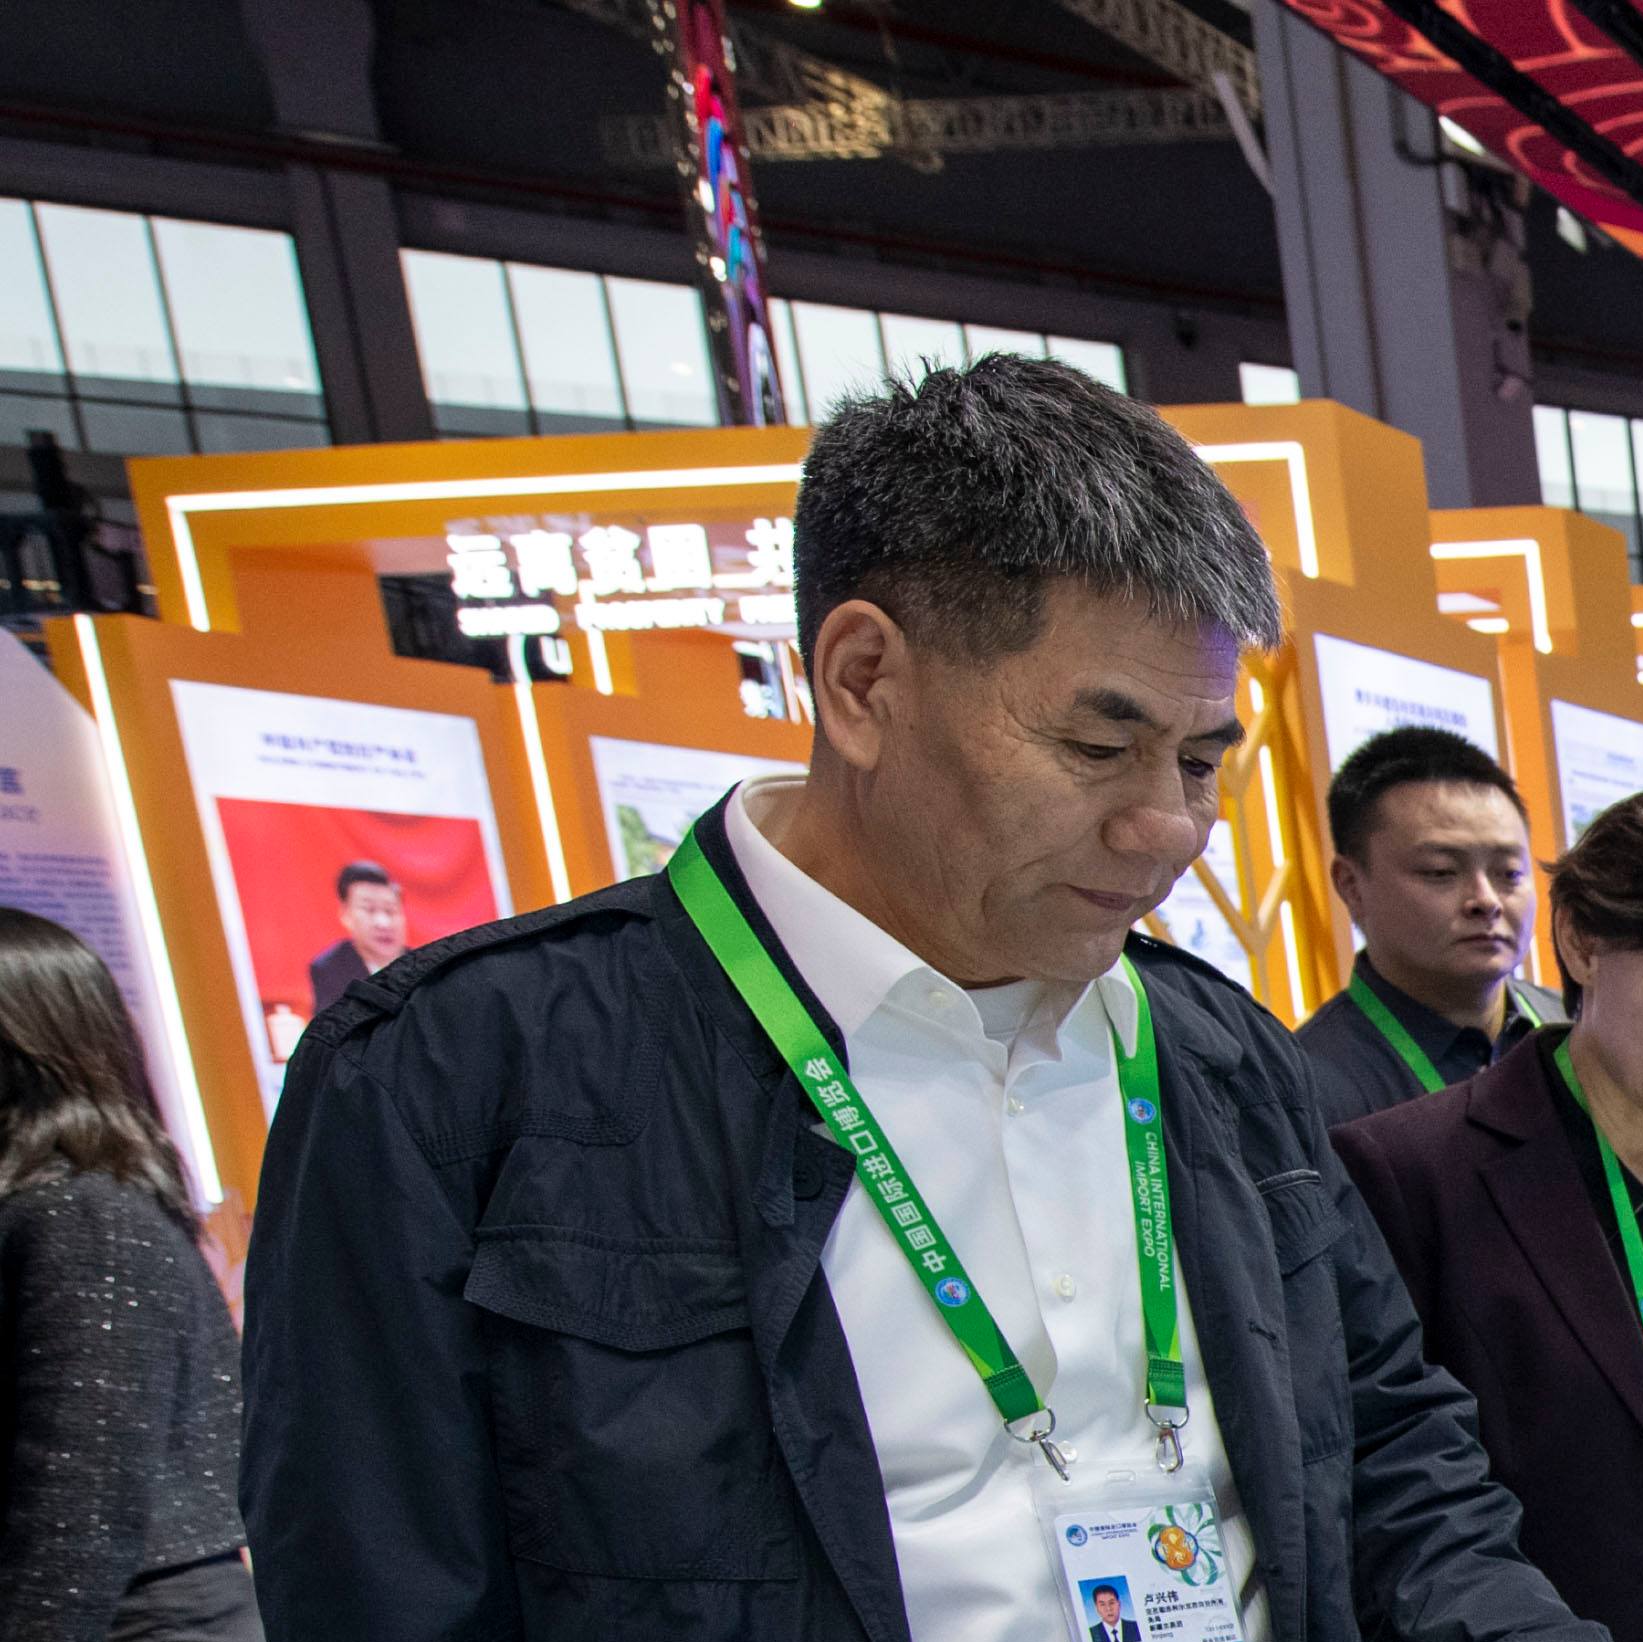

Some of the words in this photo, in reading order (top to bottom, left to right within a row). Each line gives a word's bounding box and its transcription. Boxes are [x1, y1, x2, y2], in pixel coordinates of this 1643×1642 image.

[804, 1054, 949, 1275] 中国国际进口博览会
[1143, 1130, 1160, 1178] CHINA
[1133, 1159, 1150, 1213] IMPORT
[1139, 1216, 1155, 1258] EXPO
[1149, 1179, 1171, 1292] INTERNATIONAL
